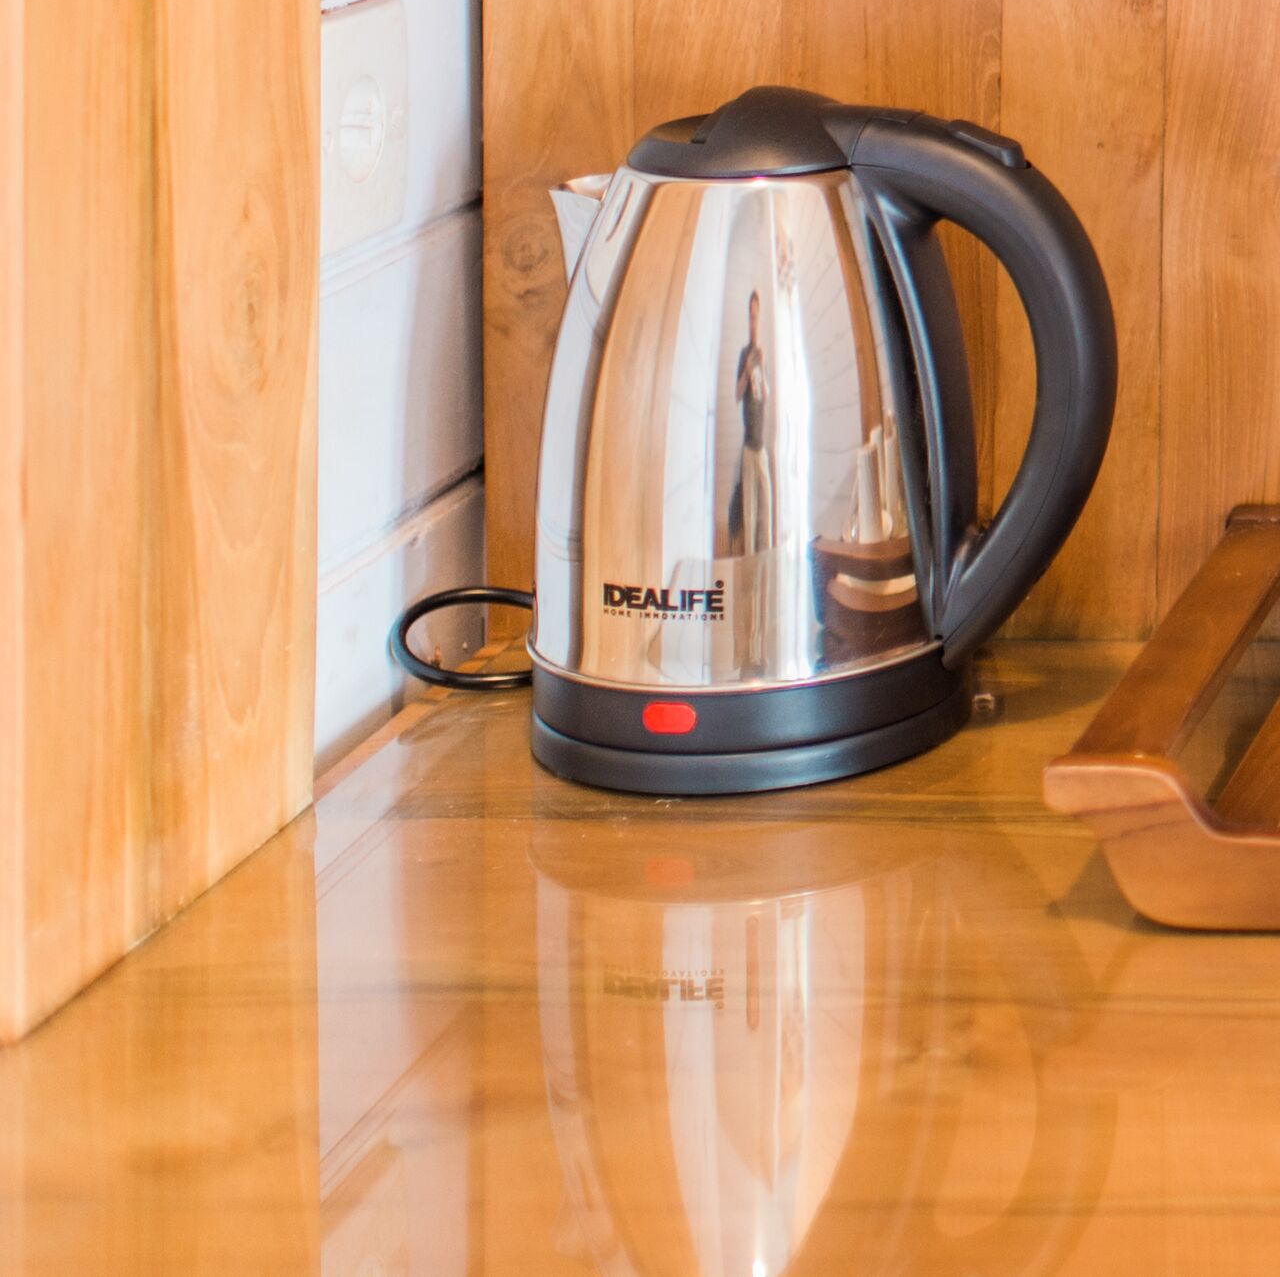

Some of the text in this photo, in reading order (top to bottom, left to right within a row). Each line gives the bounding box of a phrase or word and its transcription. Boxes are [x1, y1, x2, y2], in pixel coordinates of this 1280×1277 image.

[603, 582, 724, 612] IDEALIFE
[603, 608, 725, 621] HOME INNOVATIONS
